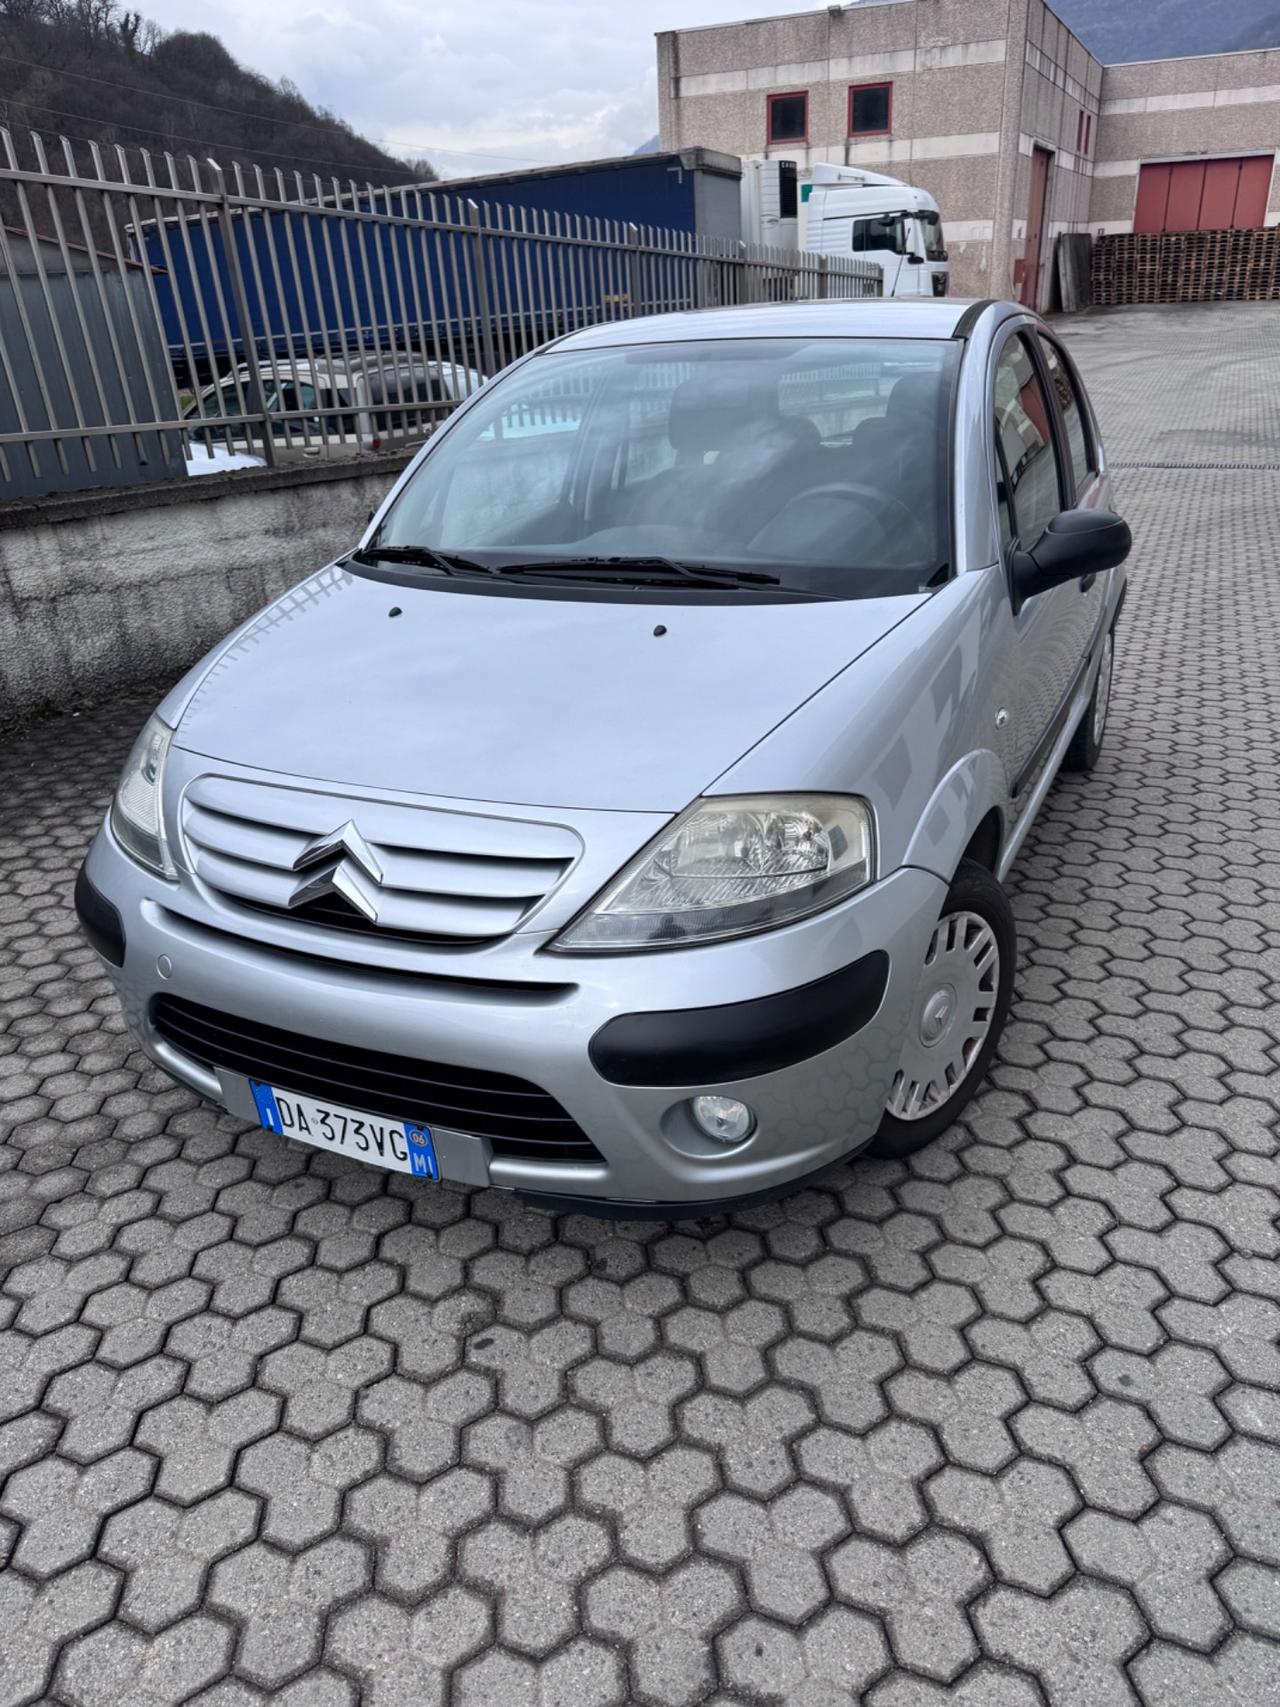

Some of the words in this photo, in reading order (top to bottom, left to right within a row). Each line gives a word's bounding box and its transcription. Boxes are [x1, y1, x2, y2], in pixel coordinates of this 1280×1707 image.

[266, 1109, 274, 1127] I
[277, 1097, 313, 1136] DA
[316, 1109, 408, 1161] 373VG
[414, 1153, 433, 1174] MI
